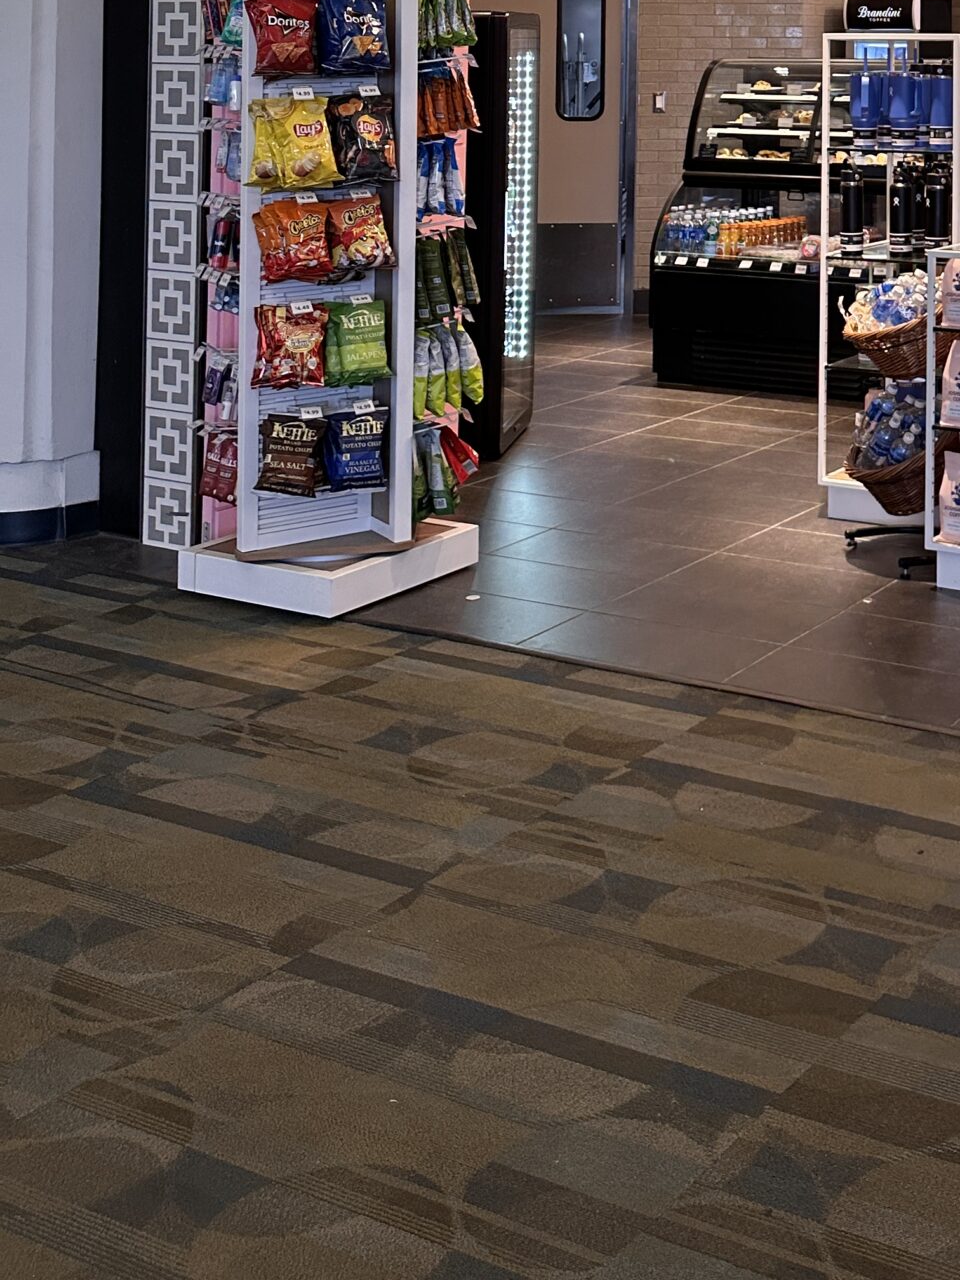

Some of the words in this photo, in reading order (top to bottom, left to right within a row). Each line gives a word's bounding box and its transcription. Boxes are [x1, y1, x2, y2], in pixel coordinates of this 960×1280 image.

[857, 5, 902, 18] Brandini
[268, 15, 309, 28] Doritos
[340, 309, 384, 329] KETTLE
[272, 422, 318, 441] KETTLE
[341, 416, 384, 436] KETTLE
[269, 444, 294, 452] POTATO
[270, 461, 285, 469] SEA
[286, 462, 306, 470] SALT
[345, 464, 380, 474] VINEGAR
